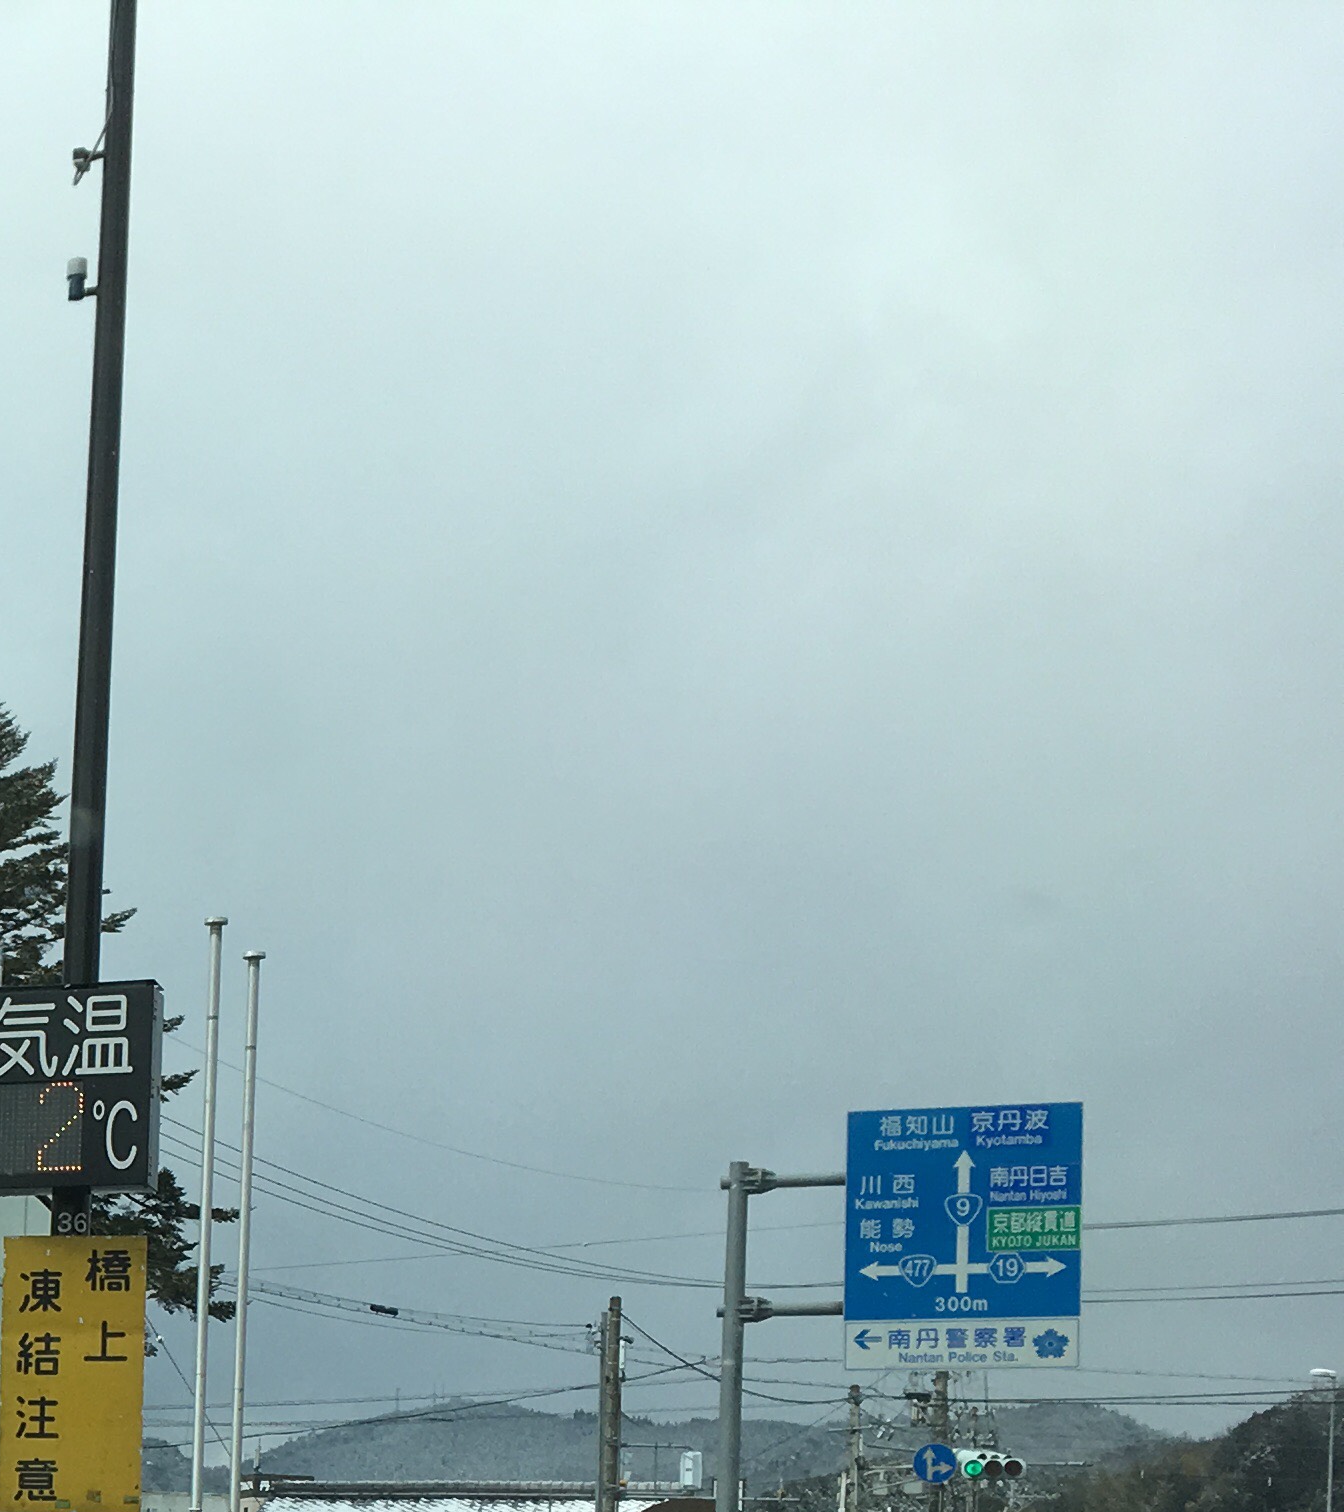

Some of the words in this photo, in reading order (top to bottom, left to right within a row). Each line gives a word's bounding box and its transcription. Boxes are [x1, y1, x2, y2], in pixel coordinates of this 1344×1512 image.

[37, 1081, 85, 1172] 2
[880, 1115, 954, 1137] 福知山
[971, 1110, 1049, 1133] 京丹波
[874, 1138, 959, 1152] Fukuchiyama
[976, 1134, 1042, 1147] Kyotamba
[860, 1174, 915, 1195] 川西
[990, 1166, 1068, 1188] 南丹日吉
[856, 1198, 918, 1210] Kawanishi
[990, 1190, 1027, 1202] Nantan
[1030, 1188, 1066, 1201] Hiyoshi
[957, 1199, 969, 1216] 9
[57, 1213, 87, 1233] 36
[860, 1218, 914, 1239] 能勢
[993, 1211, 1075, 1233] 京都縦貫道
[870, 1241, 903, 1252] Nose
[992, 1235, 1031, 1248] KYOTO
[1036, 1234, 1075, 1246] JUKAN
[905, 1259, 930, 1277] 477
[996, 1258, 1018, 1277] 19
[84, 1249, 131, 1363] 橋上
[935, 1297, 987, 1312] 300m
[888, 1327, 1026, 1349] 南丹警察署
[899, 1352, 943, 1363] Nantan
[949, 1351, 987, 1362] Police
[994, 1351, 1018, 1362] Sta.
[15, 1269, 62, 1501] 凍結注意
